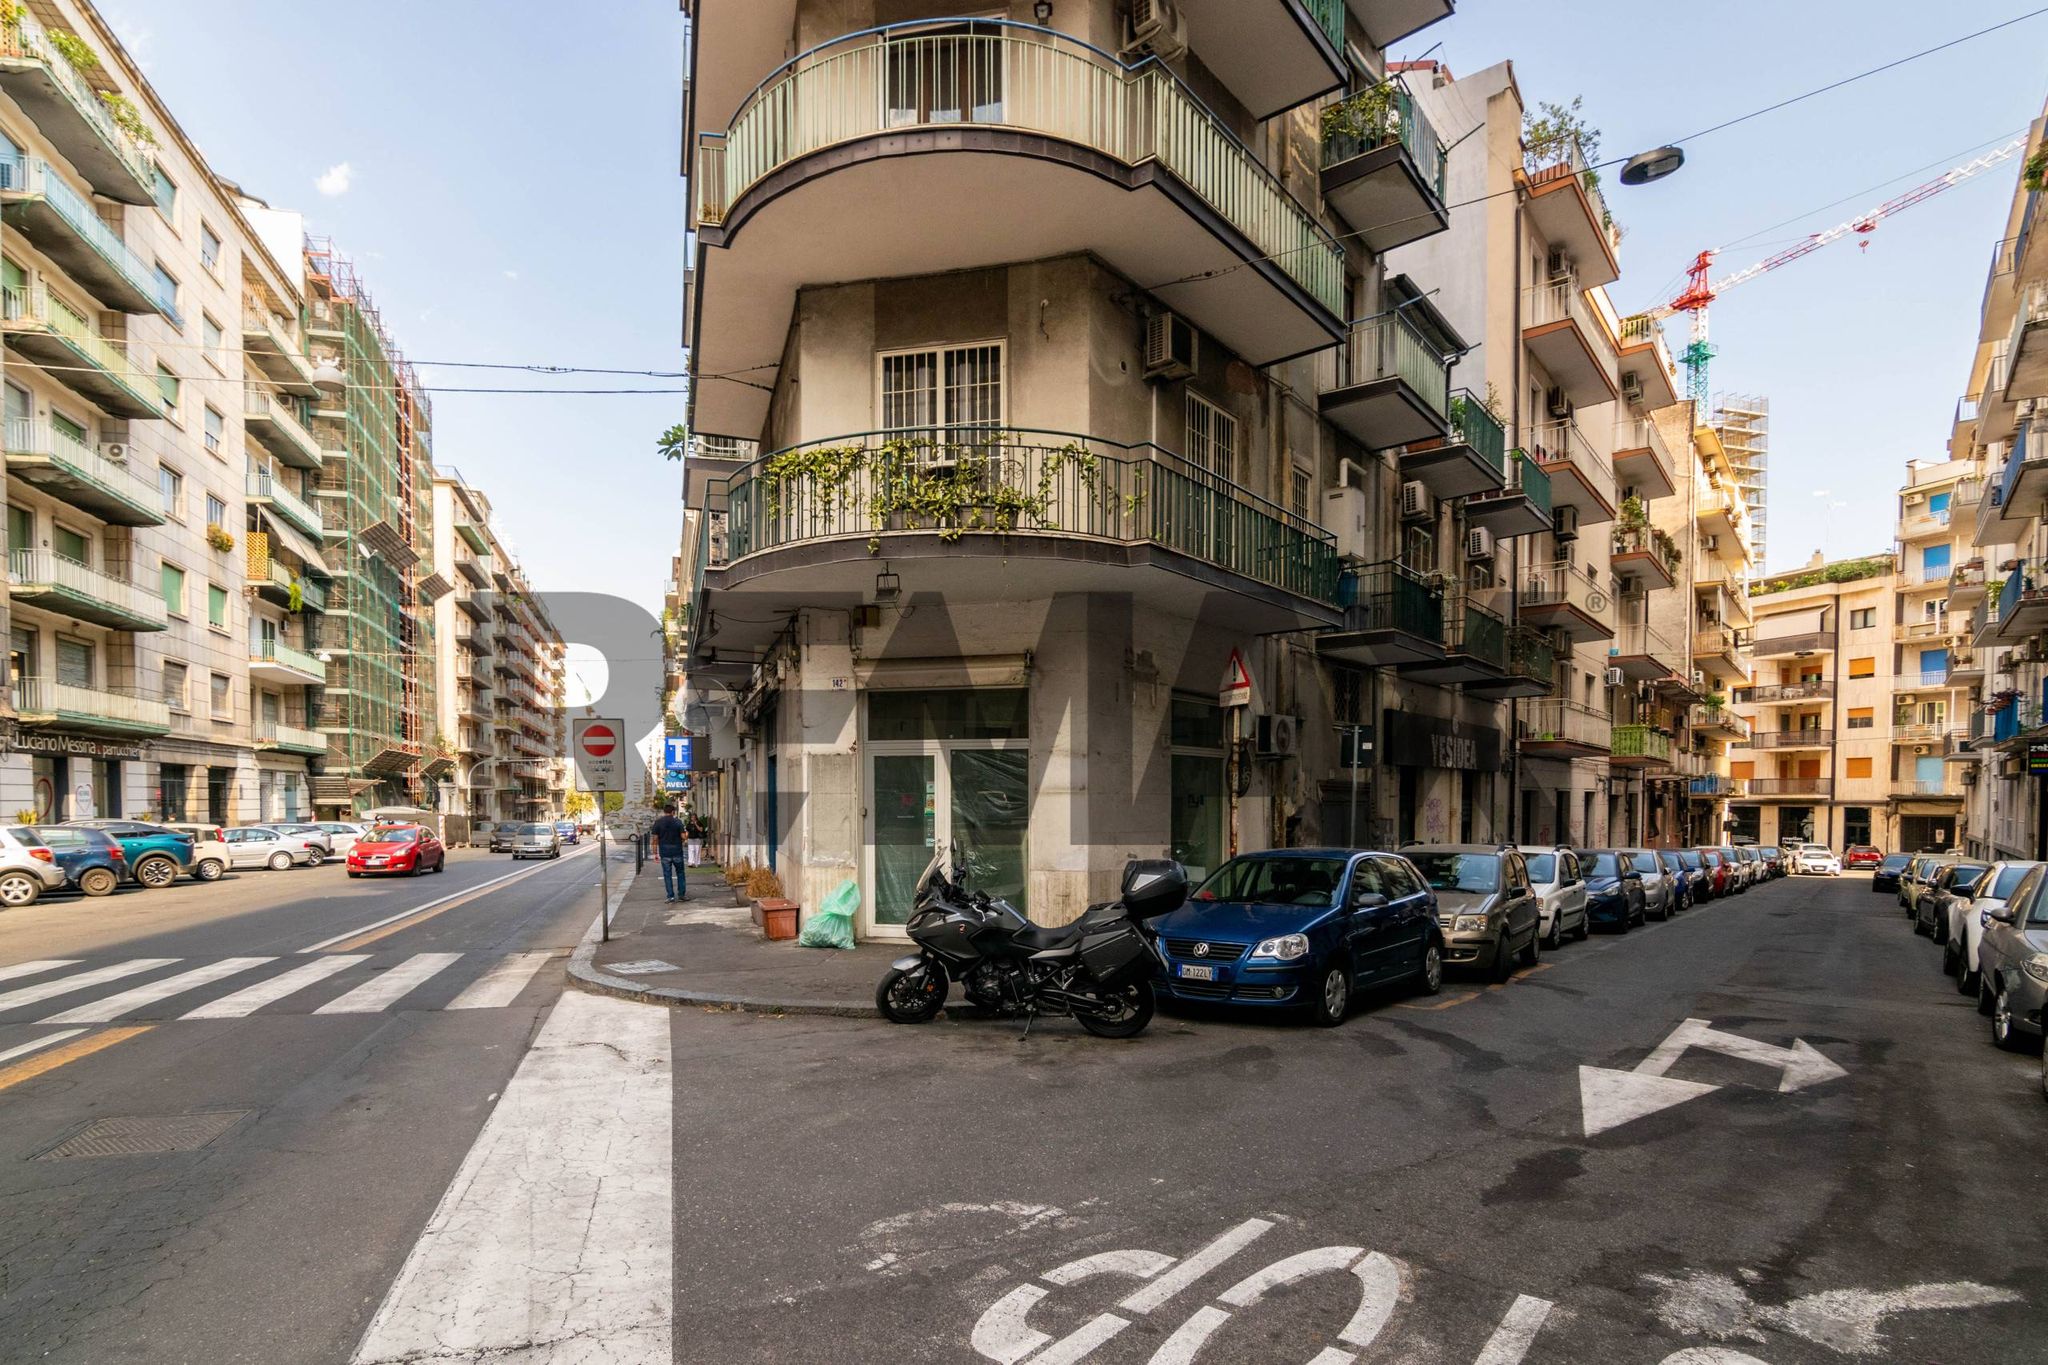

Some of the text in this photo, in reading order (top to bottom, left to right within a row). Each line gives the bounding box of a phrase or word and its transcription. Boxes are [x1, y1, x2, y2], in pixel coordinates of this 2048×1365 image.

[14, 731, 56, 751] Luciano
[58, 736, 96, 753] Messina
[1431, 734, 1477, 770] YESIDEA
